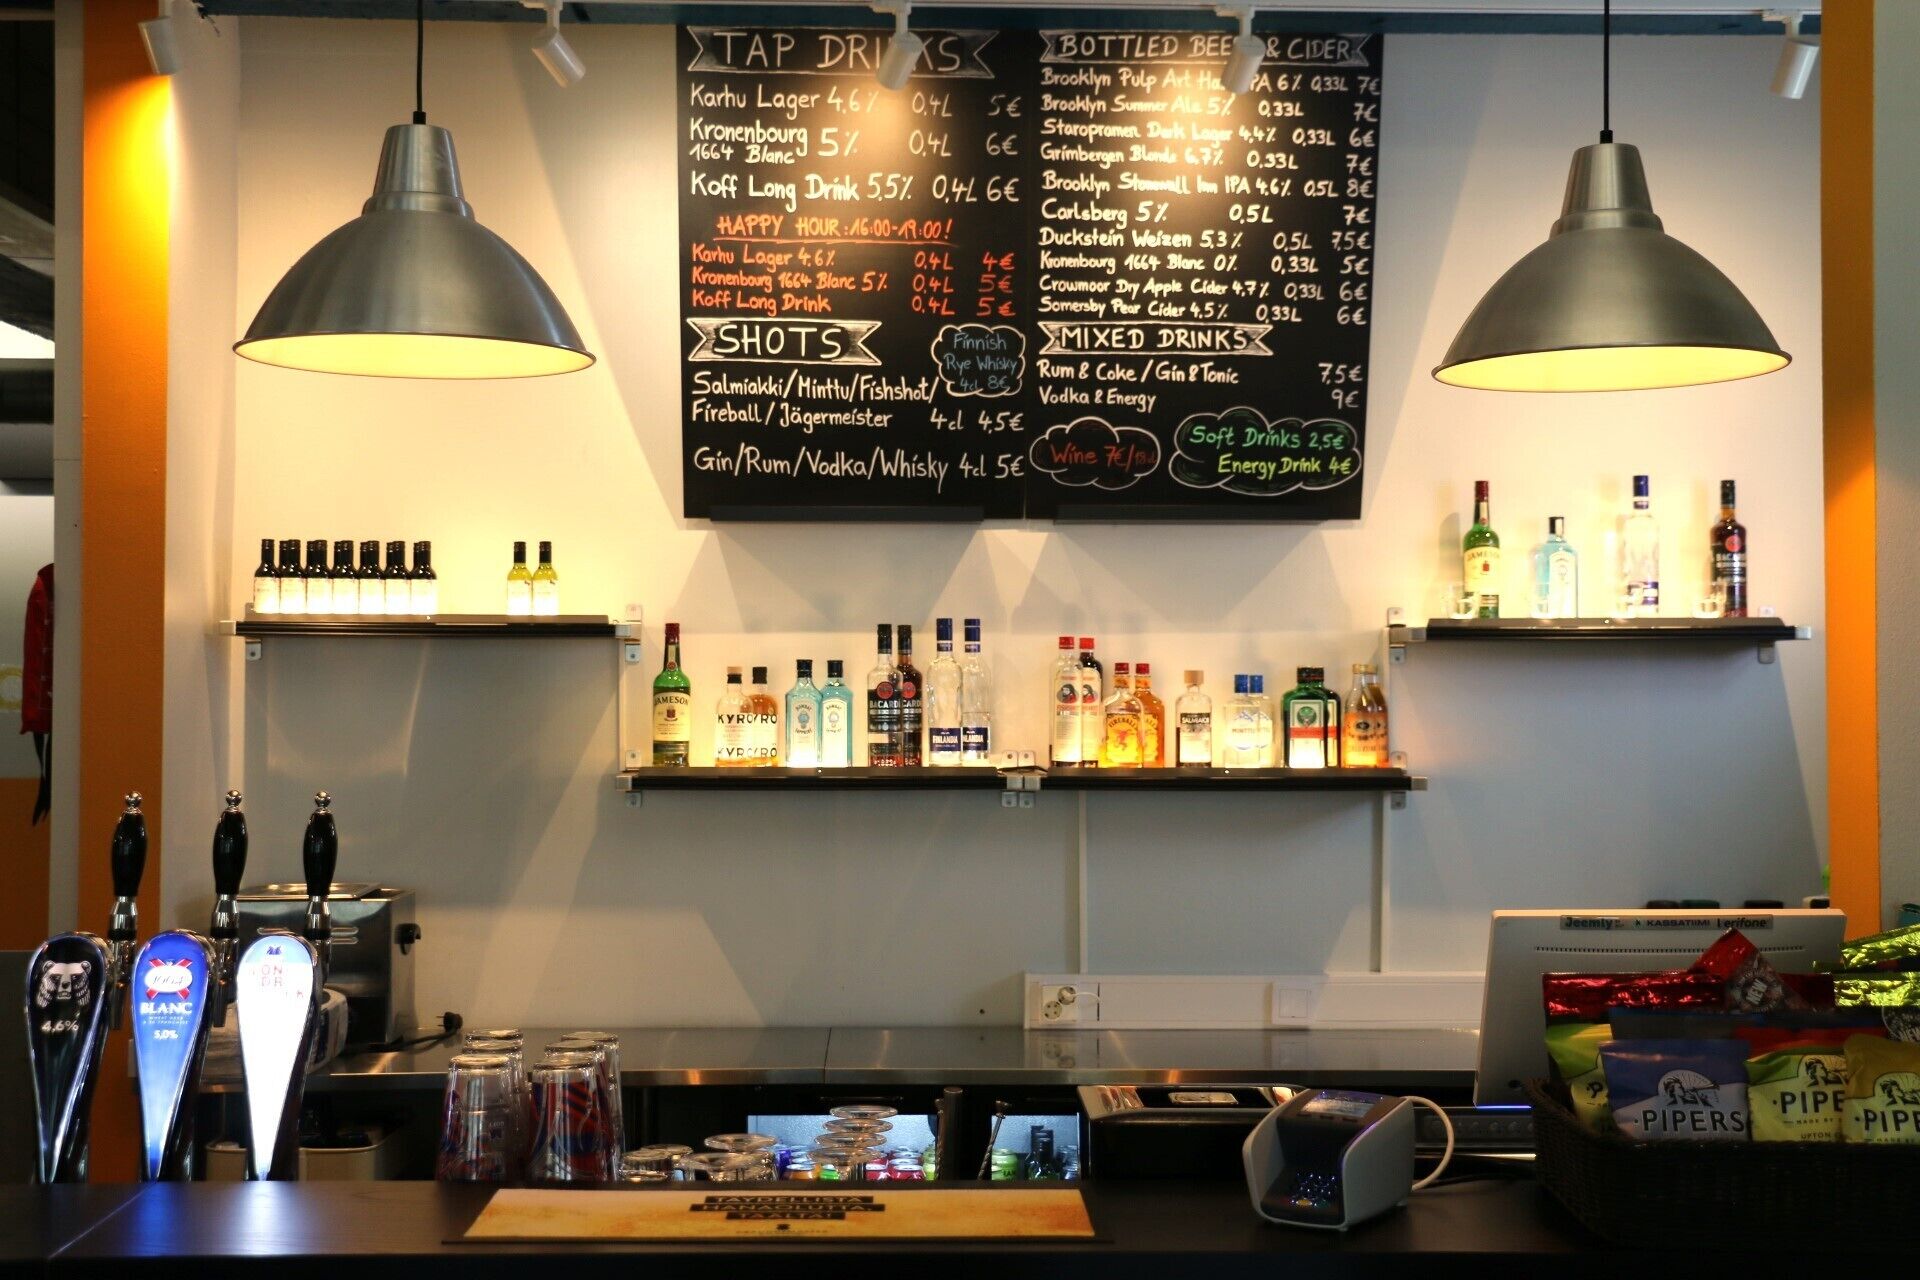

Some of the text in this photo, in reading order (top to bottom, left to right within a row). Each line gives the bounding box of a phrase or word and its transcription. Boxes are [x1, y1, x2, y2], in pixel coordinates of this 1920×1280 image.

[713, 32, 960, 71] TAP DRIKS
[1058, 34, 1349, 60] BOTTLED BEE & CIDER
[1041, 67, 1111, 95] Brooklyn
[1118, 67, 1157, 94] Pulp
[1162, 68, 1191, 88] Art
[1250, 73, 1272, 93] PA
[1357, 76, 1381, 95] 7€
[691, 82, 746, 108] Karhu
[757, 84, 820, 120] Lager
[1041, 94, 1106, 120] Brooklyn
[1111, 95, 1168, 112] Summer
[1207, 93, 1236, 116] 5%
[1354, 103, 1378, 122] 7€
[689, 117, 808, 157] Kronenbourg
[818, 127, 859, 157] 5%
[986, 132, 1018, 156] 6€
[1041, 118, 1141, 143] Staropramen
[1350, 128, 1376, 147] 6€
[689, 143, 795, 164] 1664 Blanc
[1041, 143, 1124, 169] Grimbergen
[1346, 154, 1373, 176] 7€
[691, 171, 738, 199] Koff
[749, 174, 797, 212] Long
[805, 173, 859, 200] Drink
[986, 176, 1019, 202] 6€
[1042, 170, 1110, 199] Brooklyn
[1224, 175, 1251, 195] IPA
[1346, 178, 1374, 198] 8€
[717, 215, 783, 236] HAPPY
[1041, 198, 1128, 229] Carlsberg
[1135, 200, 1169, 223] 5%
[1342, 205, 1371, 225] 7€
[1038, 226, 1124, 247] Duckstein
[1131, 229, 1192, 247] Weizen
[691, 243, 734, 264] Karhu
[743, 244, 792, 272] Lager
[983, 252, 1015, 271] 4€
[1039, 250, 1116, 274] Kronenbourg
[1124, 254, 1161, 271] 1664
[1167, 253, 1205, 270] Blanc
[1213, 254, 1238, 272] 0%
[1339, 255, 1370, 275] 5€
[691, 266, 772, 293] Kronenbourg
[778, 272, 811, 289] 1664
[816, 272, 856, 290] Blanc
[861, 271, 888, 292] 5%
[978, 274, 1013, 293] 5€
[1039, 274, 1111, 292] Crowmoor
[1115, 279, 1140, 300] Dry
[1143, 277, 1183, 298] Apple
[1190, 278, 1228, 295] Cider
[1339, 281, 1368, 301] 6€
[692, 289, 732, 308] Koff
[736, 291, 777, 317] Long
[782, 293, 832, 313] Drink
[976, 297, 1016, 316] 5€
[1038, 296, 1107, 318] Somersby
[1111, 298, 1141, 314] Pear
[1148, 301, 1186, 317] Cider
[1336, 306, 1367, 325] 6€
[714, 324, 842, 359] SHOTS
[953, 332, 1007, 350] Finnish
[1060, 328, 1249, 350] MIXED DRINKS
[944, 353, 1017, 375] Rye Whisky
[1036, 359, 1075, 379] Rum
[1079, 361, 1089, 379] &
[1096, 363, 1137, 382] Coke
[1200, 362, 1239, 384] Tonic
[1039, 385, 1359, 413] Vodka & Energy 9€
[780, 402, 893, 433] Jägermeister
[930, 408, 963, 430] 4cl
[1189, 426, 1234, 449] Soft
[1242, 428, 1300, 448] Drinks
[959, 452, 987, 479] 4cl
[995, 454, 1024, 479] 5€
[1050, 442, 1097, 464] Wine
[1218, 453, 1352, 480] Energy Drink 4€
[139, 1002, 193, 1015] BLANC
[1780, 1090, 1845, 1114] PIPE
[1642, 1109, 1745, 1132] PIPERS
[1863, 1108, 1920, 1133] PIPE
